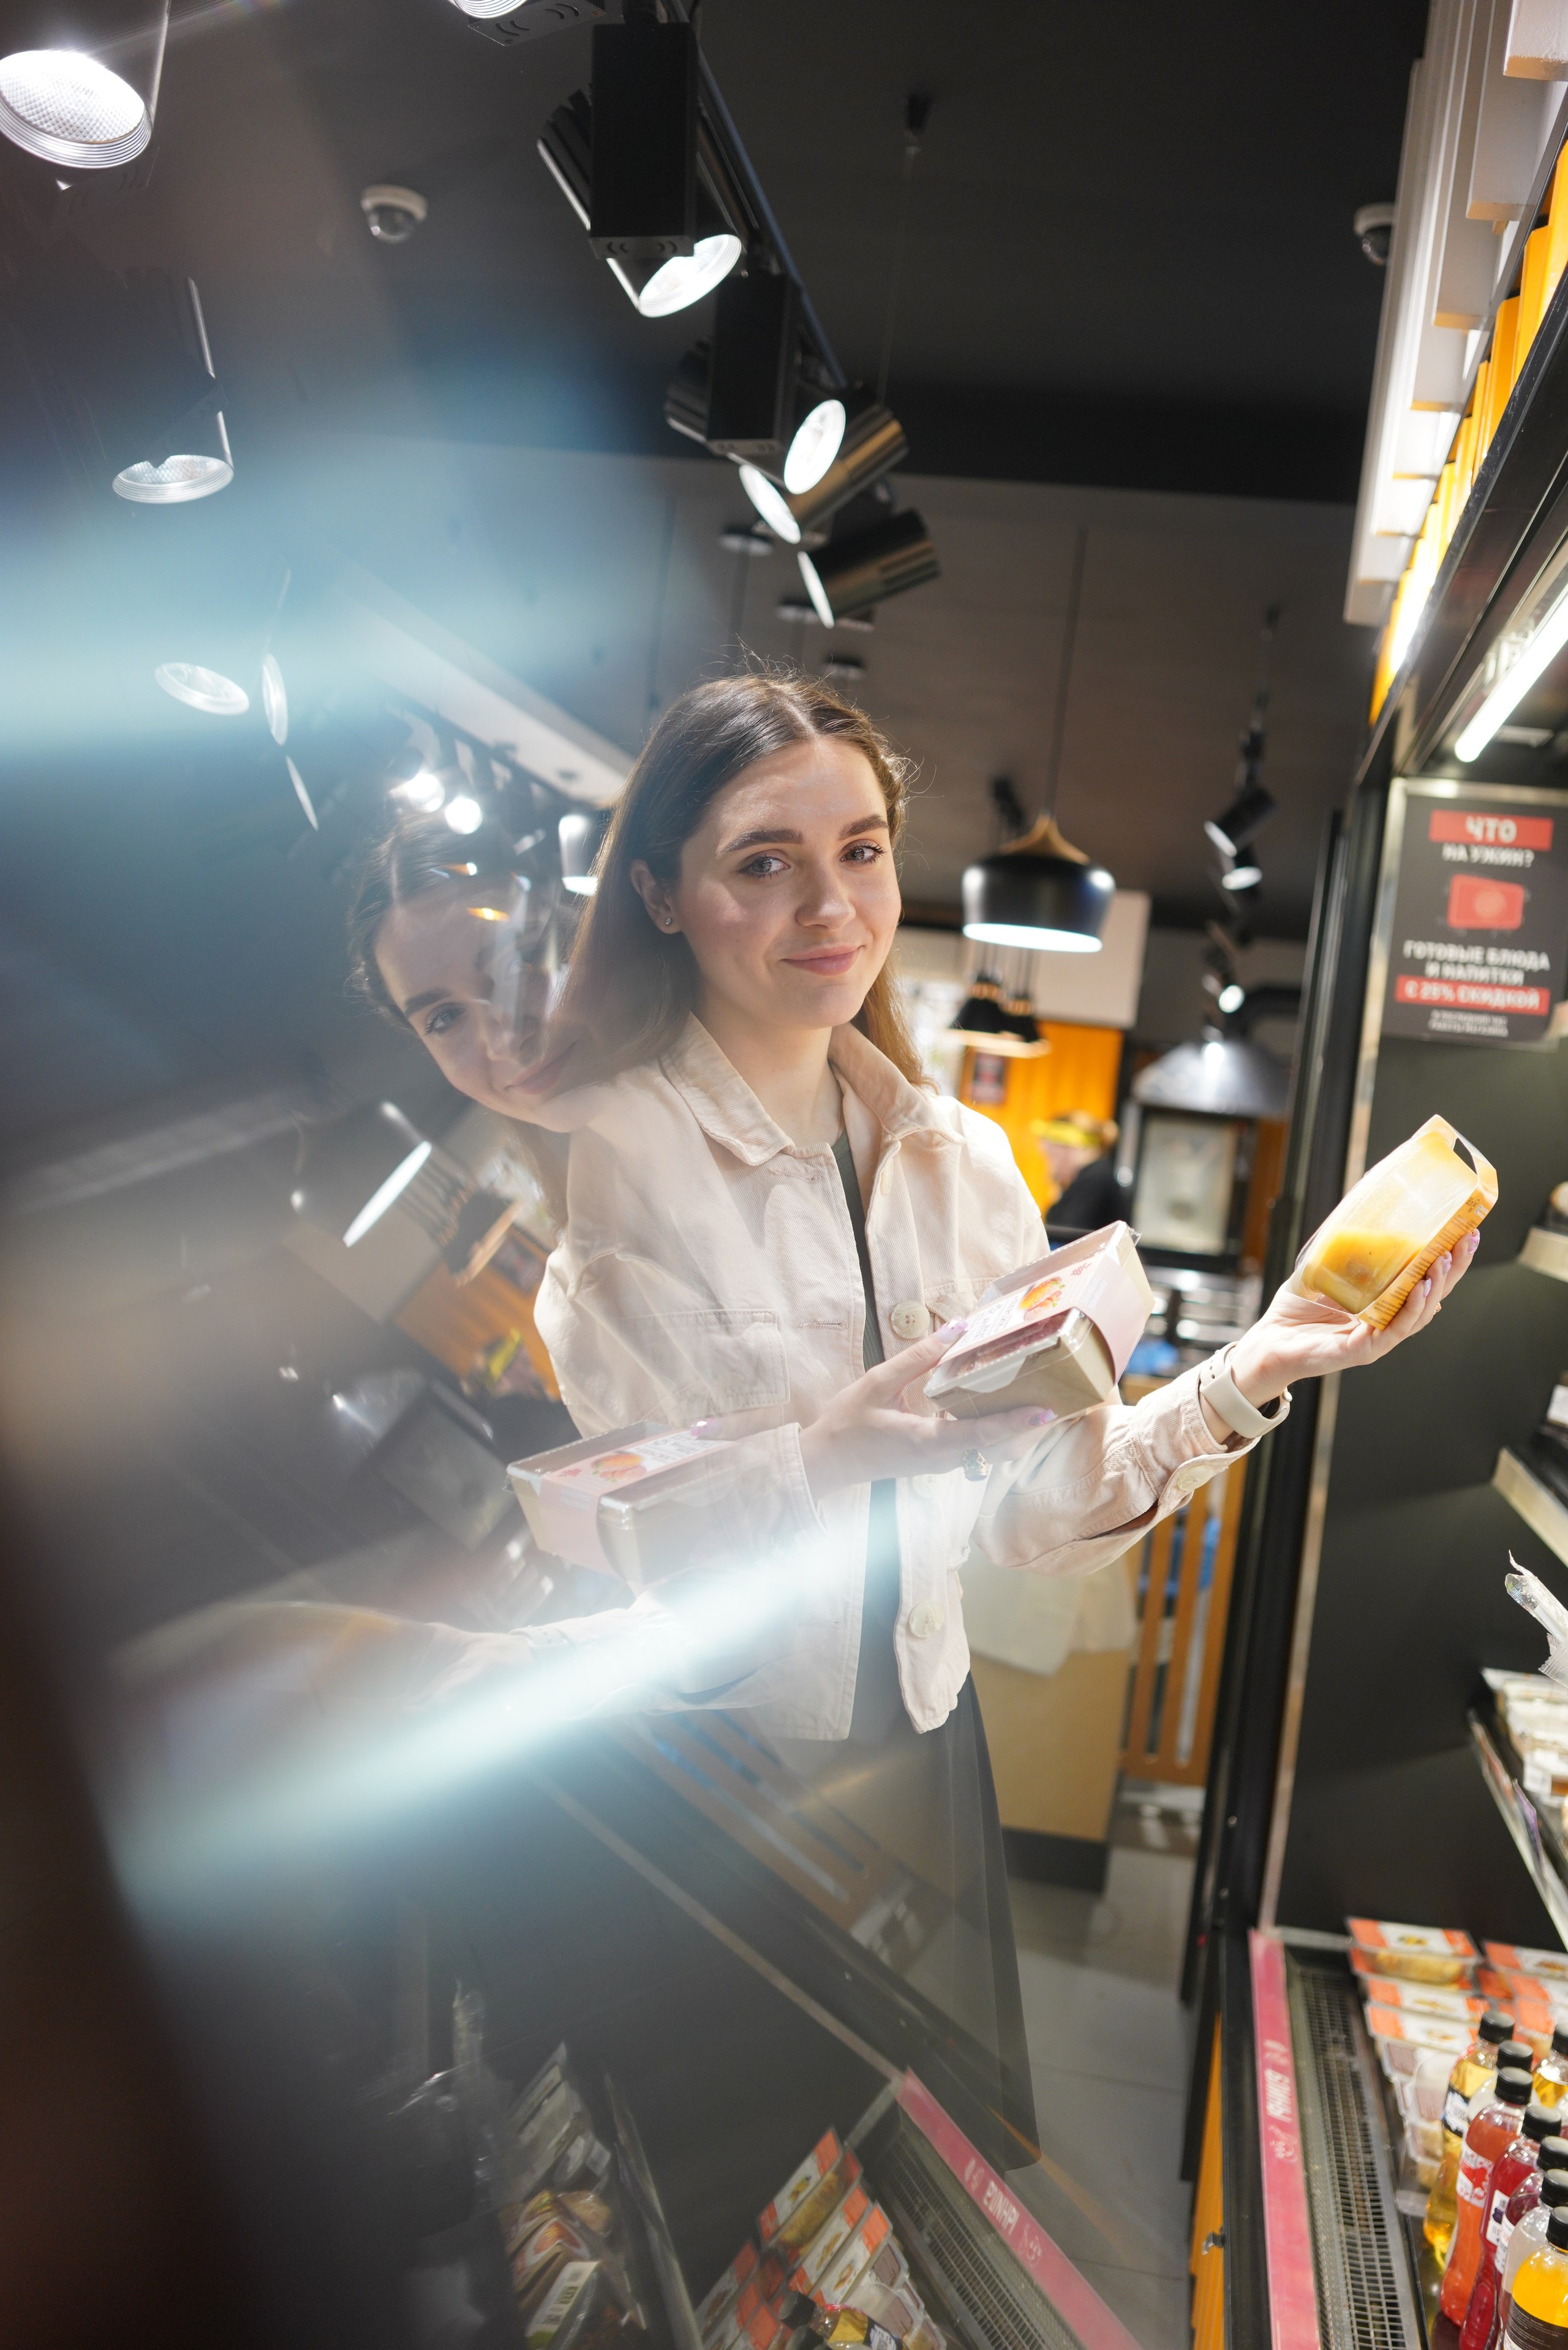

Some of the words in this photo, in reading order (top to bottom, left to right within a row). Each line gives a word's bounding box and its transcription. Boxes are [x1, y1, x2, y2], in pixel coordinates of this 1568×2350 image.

[1465, 815, 1517, 844] ЧТО
[1442, 845, 1468, 862] НА
[1469, 846, 1534, 868] УЖИН?
[1403, 939, 1484, 964] ГОТОВЫЕ
[1486, 946, 1551, 972] БЛЮДА
[1425, 961, 1439, 978] И
[1441, 962, 1525, 986] НАПИТКИ
[1404, 980, 1419, 999] С
[1457, 984, 1540, 1010] СКИДКОЙ
[1263, 2068, 1293, 2123] БЛИНЫ
